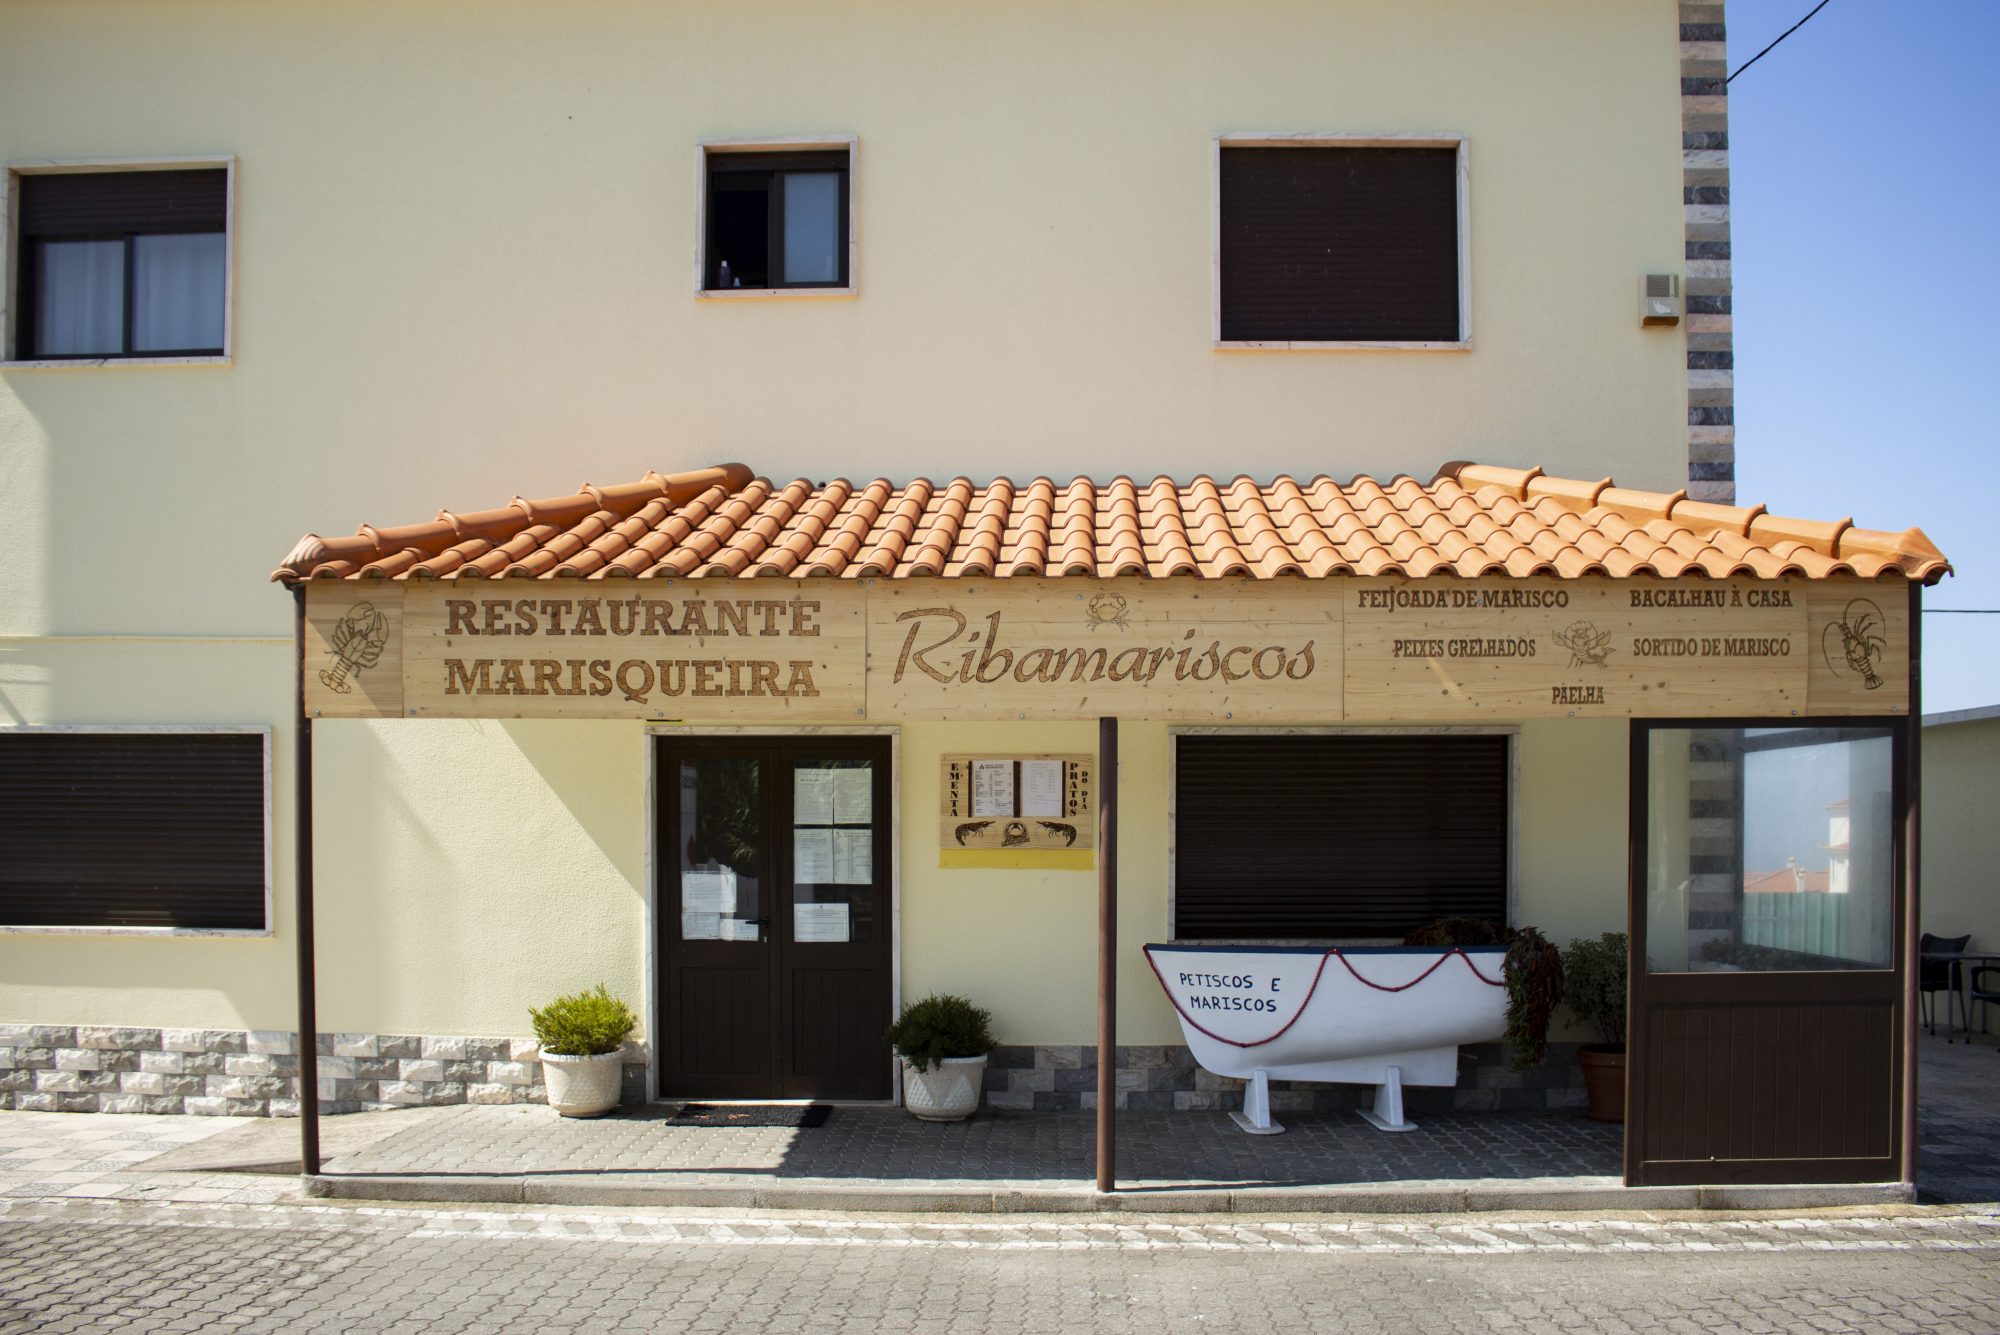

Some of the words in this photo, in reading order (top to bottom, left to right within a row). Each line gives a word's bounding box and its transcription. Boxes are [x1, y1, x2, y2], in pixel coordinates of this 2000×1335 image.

[1358, 588, 1448, 613] FEIJOADA
[1452, 590, 1478, 608] DE
[1482, 590, 1569, 608] MARISCO
[1630, 590, 1726, 607] BACALHAU
[1730, 585, 1743, 607] À
[1747, 590, 1793, 607] CASA
[444, 599, 821, 637] RESTAURANTE
[893, 607, 1315, 686] Ribamariscos
[1393, 639, 1444, 658] PEIXES
[1448, 639, 1536, 657] GRELHADOS
[1633, 638, 1697, 656] SORTIDO
[1701, 638, 1721, 656] DE
[1724, 638, 1790, 656] MARISCO
[444, 658, 820, 704] MARISQUEIRA
[1552, 686, 1604, 704] PAELHA
[1081, 771, 1089, 784] DO
[949, 762, 961, 817] EMENTA
[1069, 762, 1079, 817] PRATOS
[1180, 972, 1253, 989] PETISCOS
[1271, 977, 1281, 992] E
[1190, 995, 1277, 1013] MARISCOS
